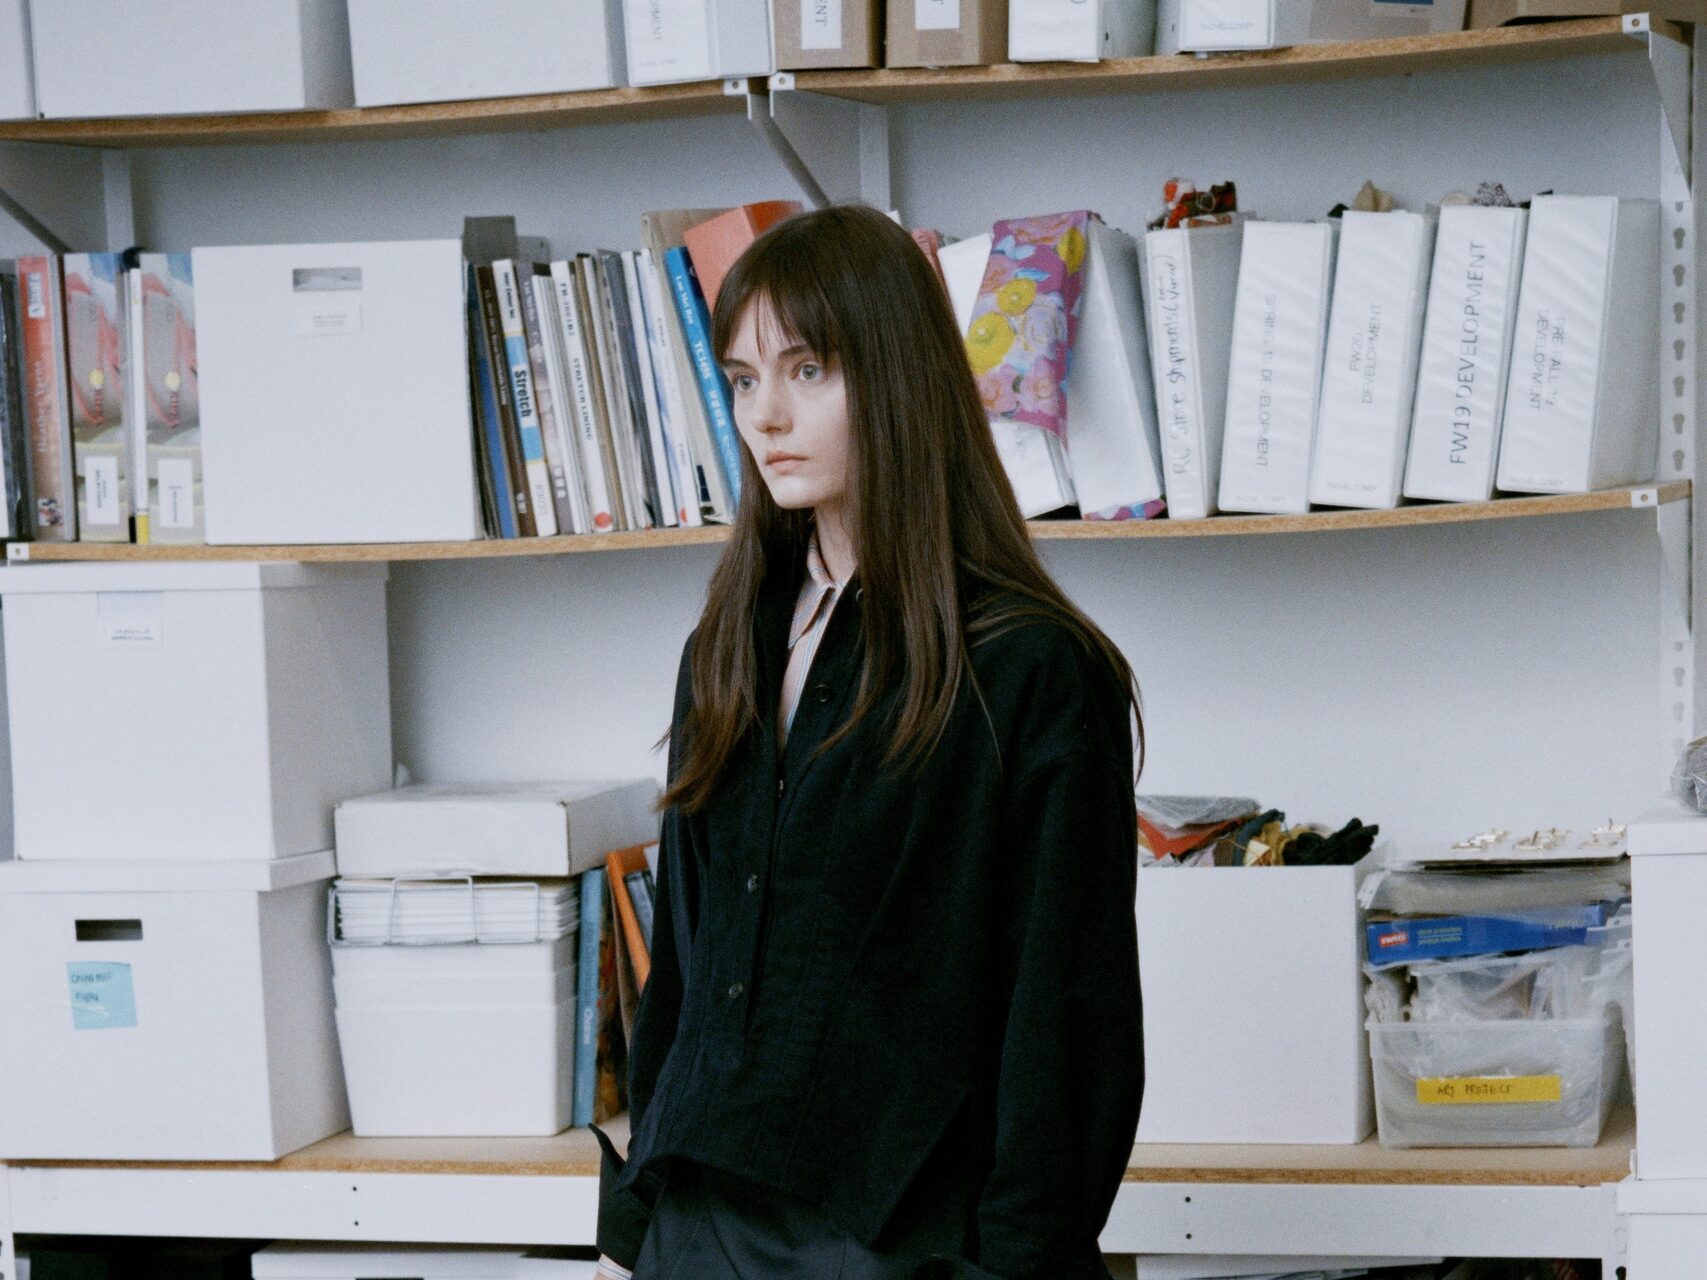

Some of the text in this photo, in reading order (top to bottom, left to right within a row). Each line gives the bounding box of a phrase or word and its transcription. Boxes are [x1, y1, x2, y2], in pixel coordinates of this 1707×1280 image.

[1263, 294, 1276, 342] SPRING
[1350, 332, 1362, 372] FW20
[1362, 303, 1381, 404] DEVELOPMENT
[1450, 240, 1486, 465] FW19 DEVELOPMENT
[1530, 310, 1548, 410] DEVELOPMENT
[514, 370, 532, 418] Stretch
[573, 357, 593, 441] STRETCH LINING
[1257, 368, 1273, 468] DEVELOPMENT
